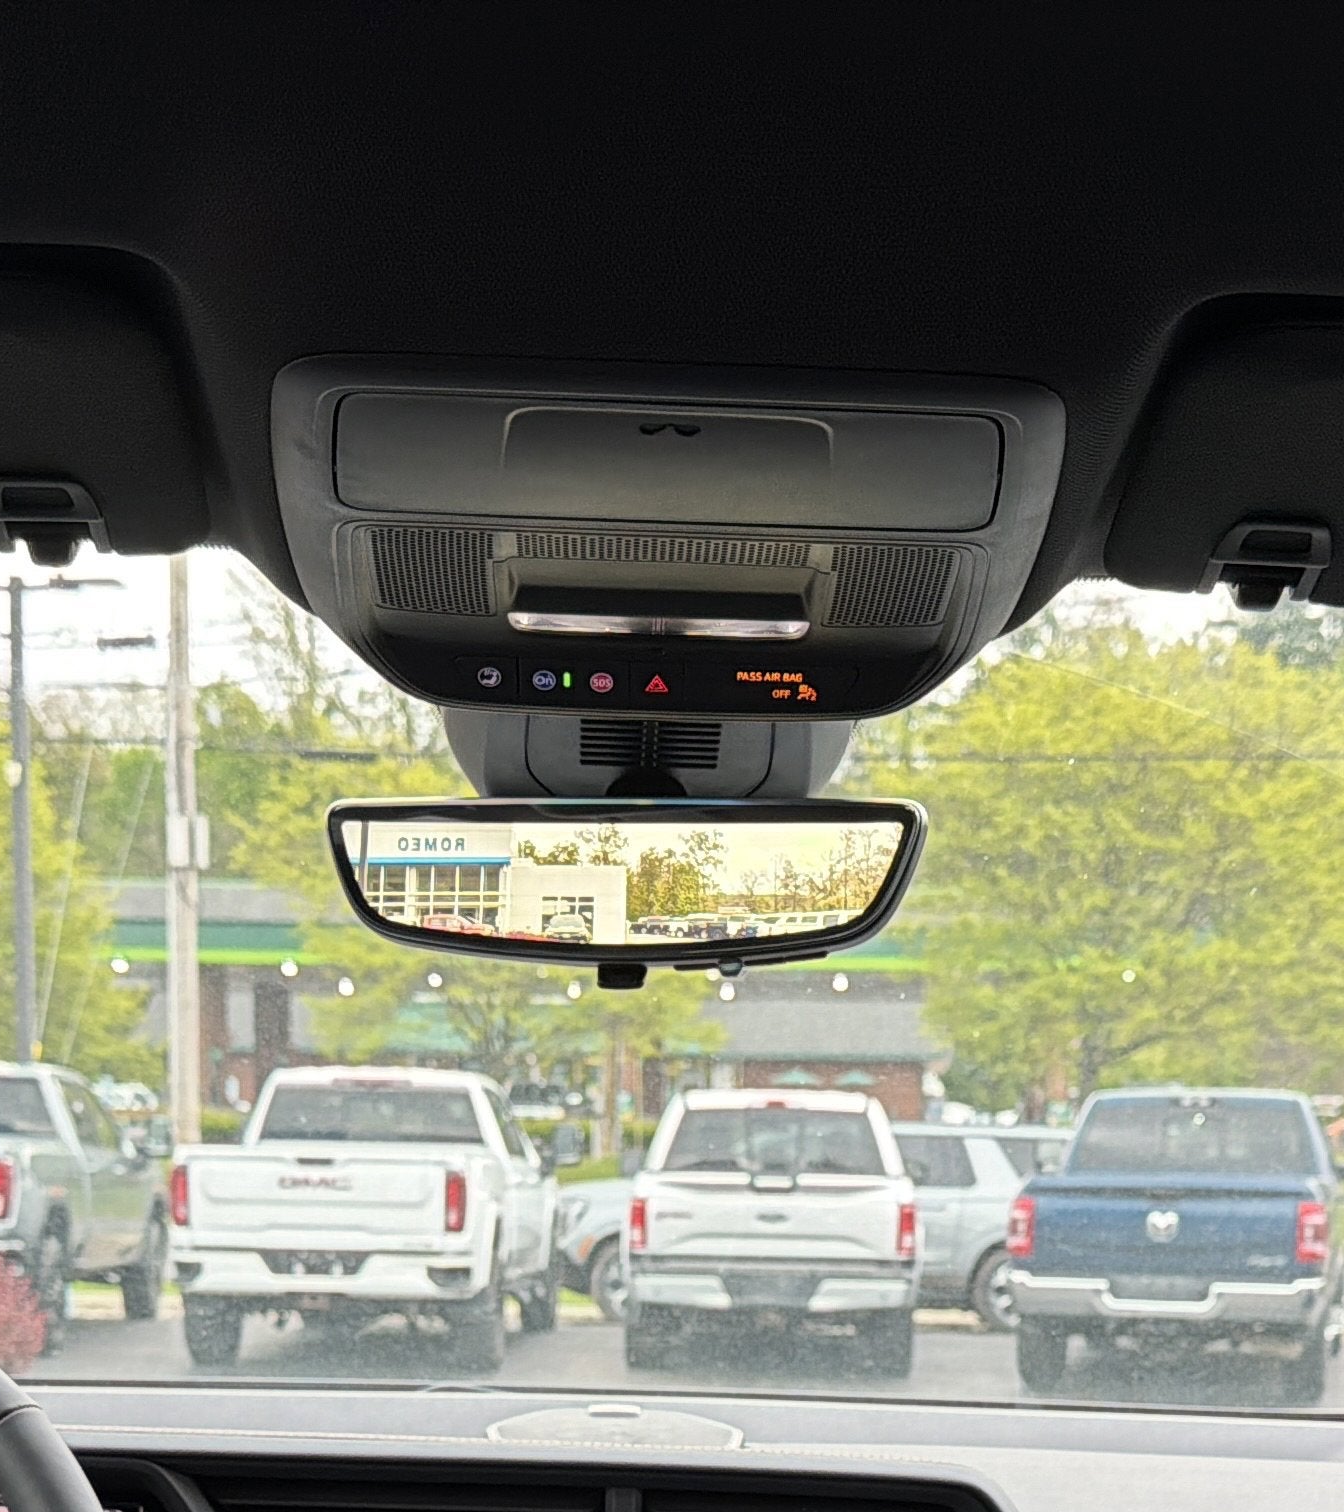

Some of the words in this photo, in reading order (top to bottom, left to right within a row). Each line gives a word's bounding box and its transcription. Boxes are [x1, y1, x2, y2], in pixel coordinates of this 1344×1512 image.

[736, 671, 762, 682] PASS
[764, 672, 781, 682] AIR
[783, 672, 803, 682] BAG
[772, 689, 791, 700] OFF
